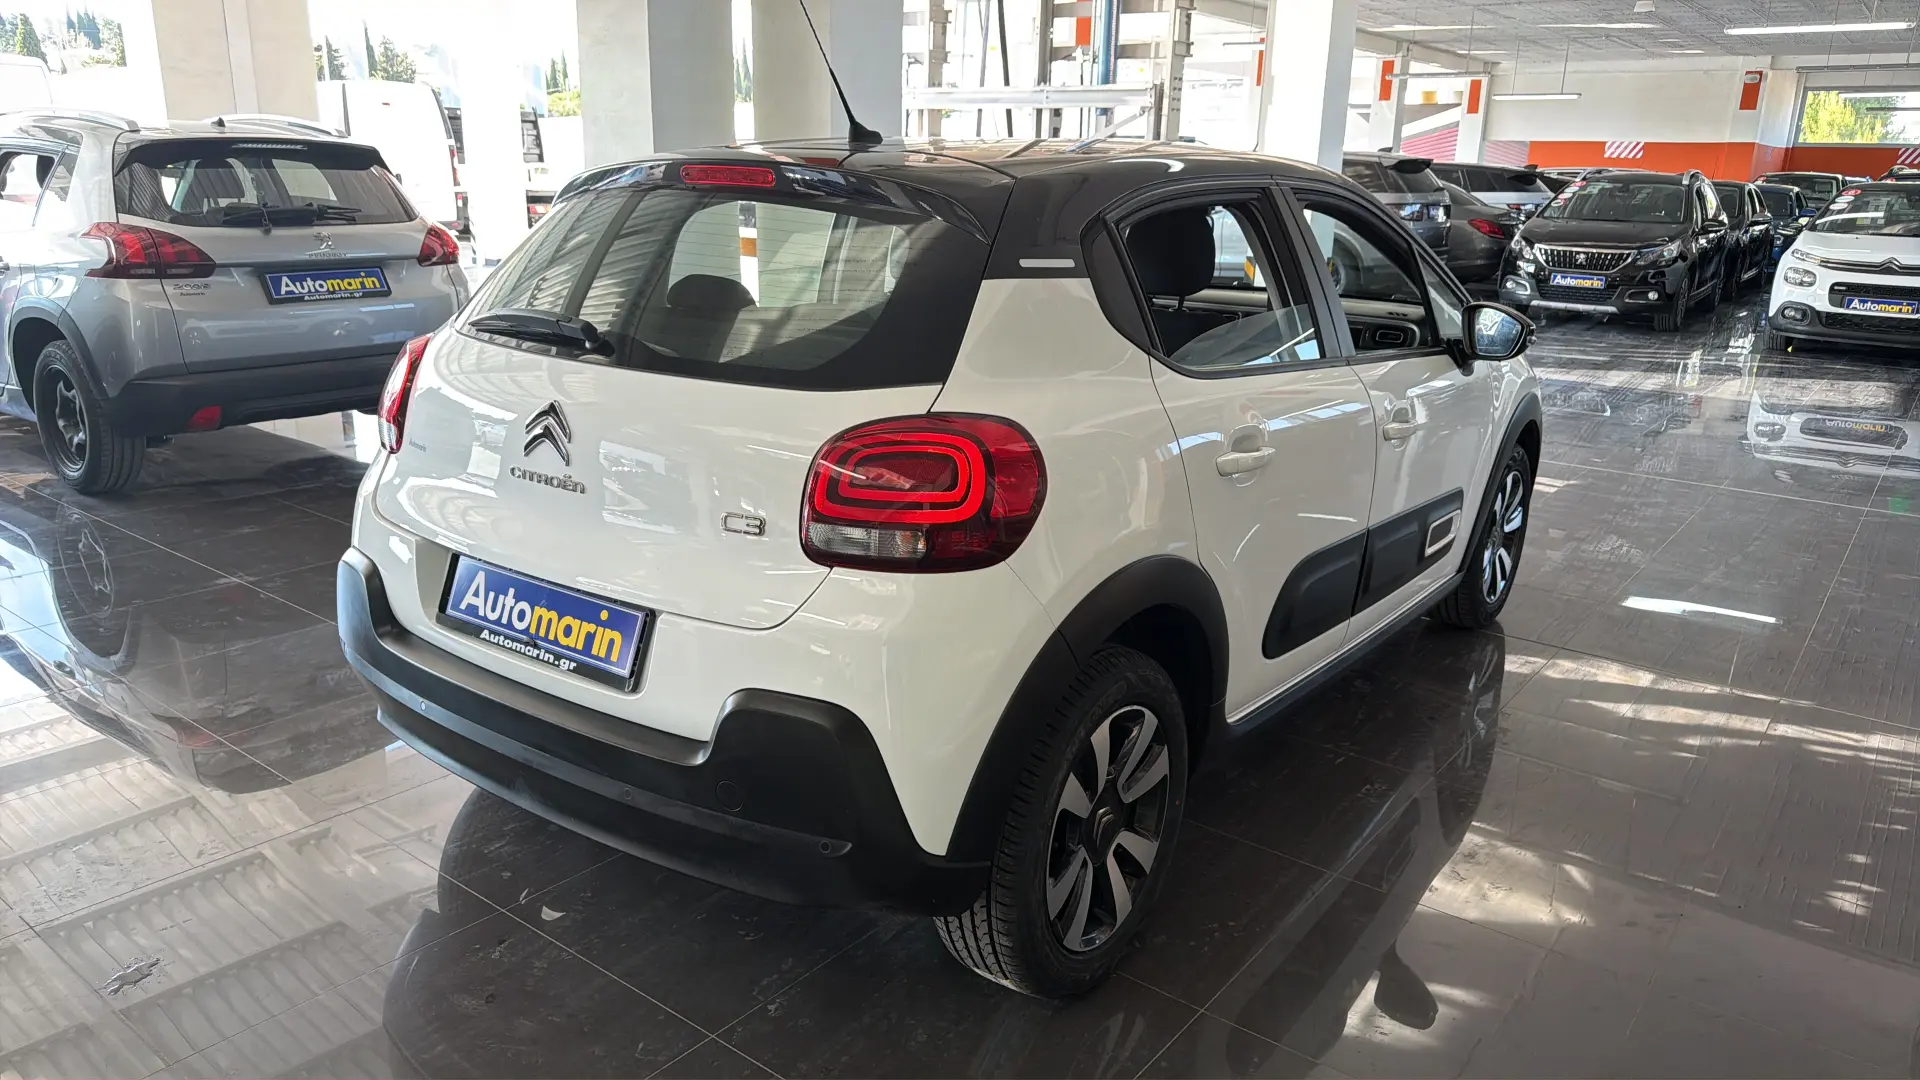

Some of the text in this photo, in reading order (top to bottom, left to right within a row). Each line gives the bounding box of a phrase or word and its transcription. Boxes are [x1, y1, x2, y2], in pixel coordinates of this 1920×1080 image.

[280, 272, 381, 295] Automarin
[1554, 274, 1604, 288] Automarin
[304, 291, 363, 301] Automarin.gr
[1849, 298, 1913, 314] Automarin
[720, 511, 766, 537] C3
[459, 570, 622, 663] Automarin
[479, 628, 577, 671] Automarin.gr
